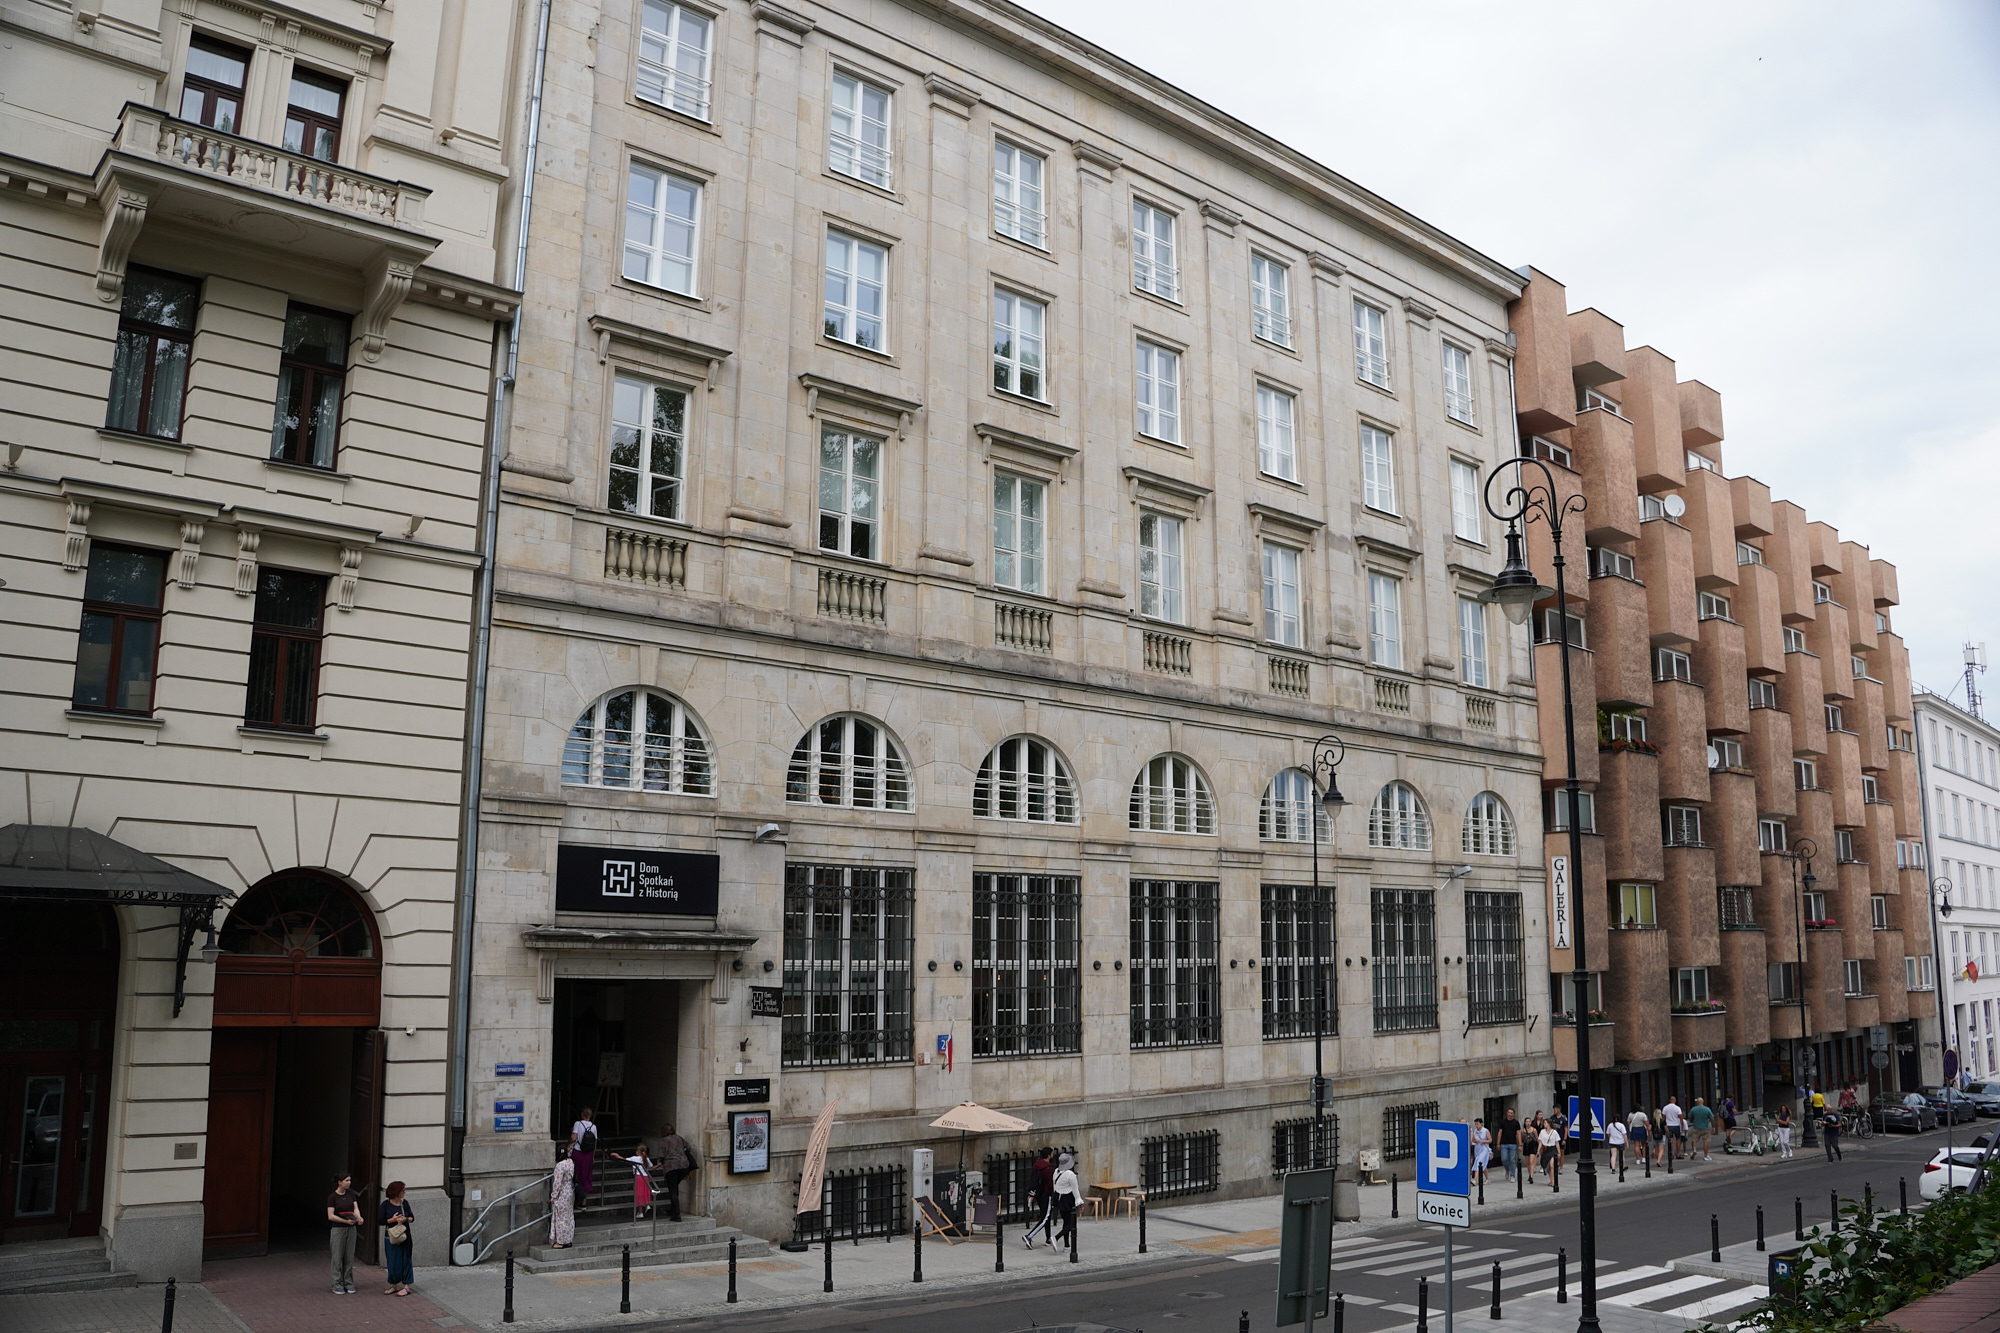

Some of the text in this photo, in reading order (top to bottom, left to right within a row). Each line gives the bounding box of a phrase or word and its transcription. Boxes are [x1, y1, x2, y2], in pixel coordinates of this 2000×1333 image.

[639, 862, 659, 873] Dom
[639, 874, 673, 887] Spotkań
[638, 887, 678, 901] z Historią
[1553, 858, 1567, 947] GALERIA
[1428, 1128, 1458, 1184] P
[1422, 1200, 1464, 1219] Koniec
